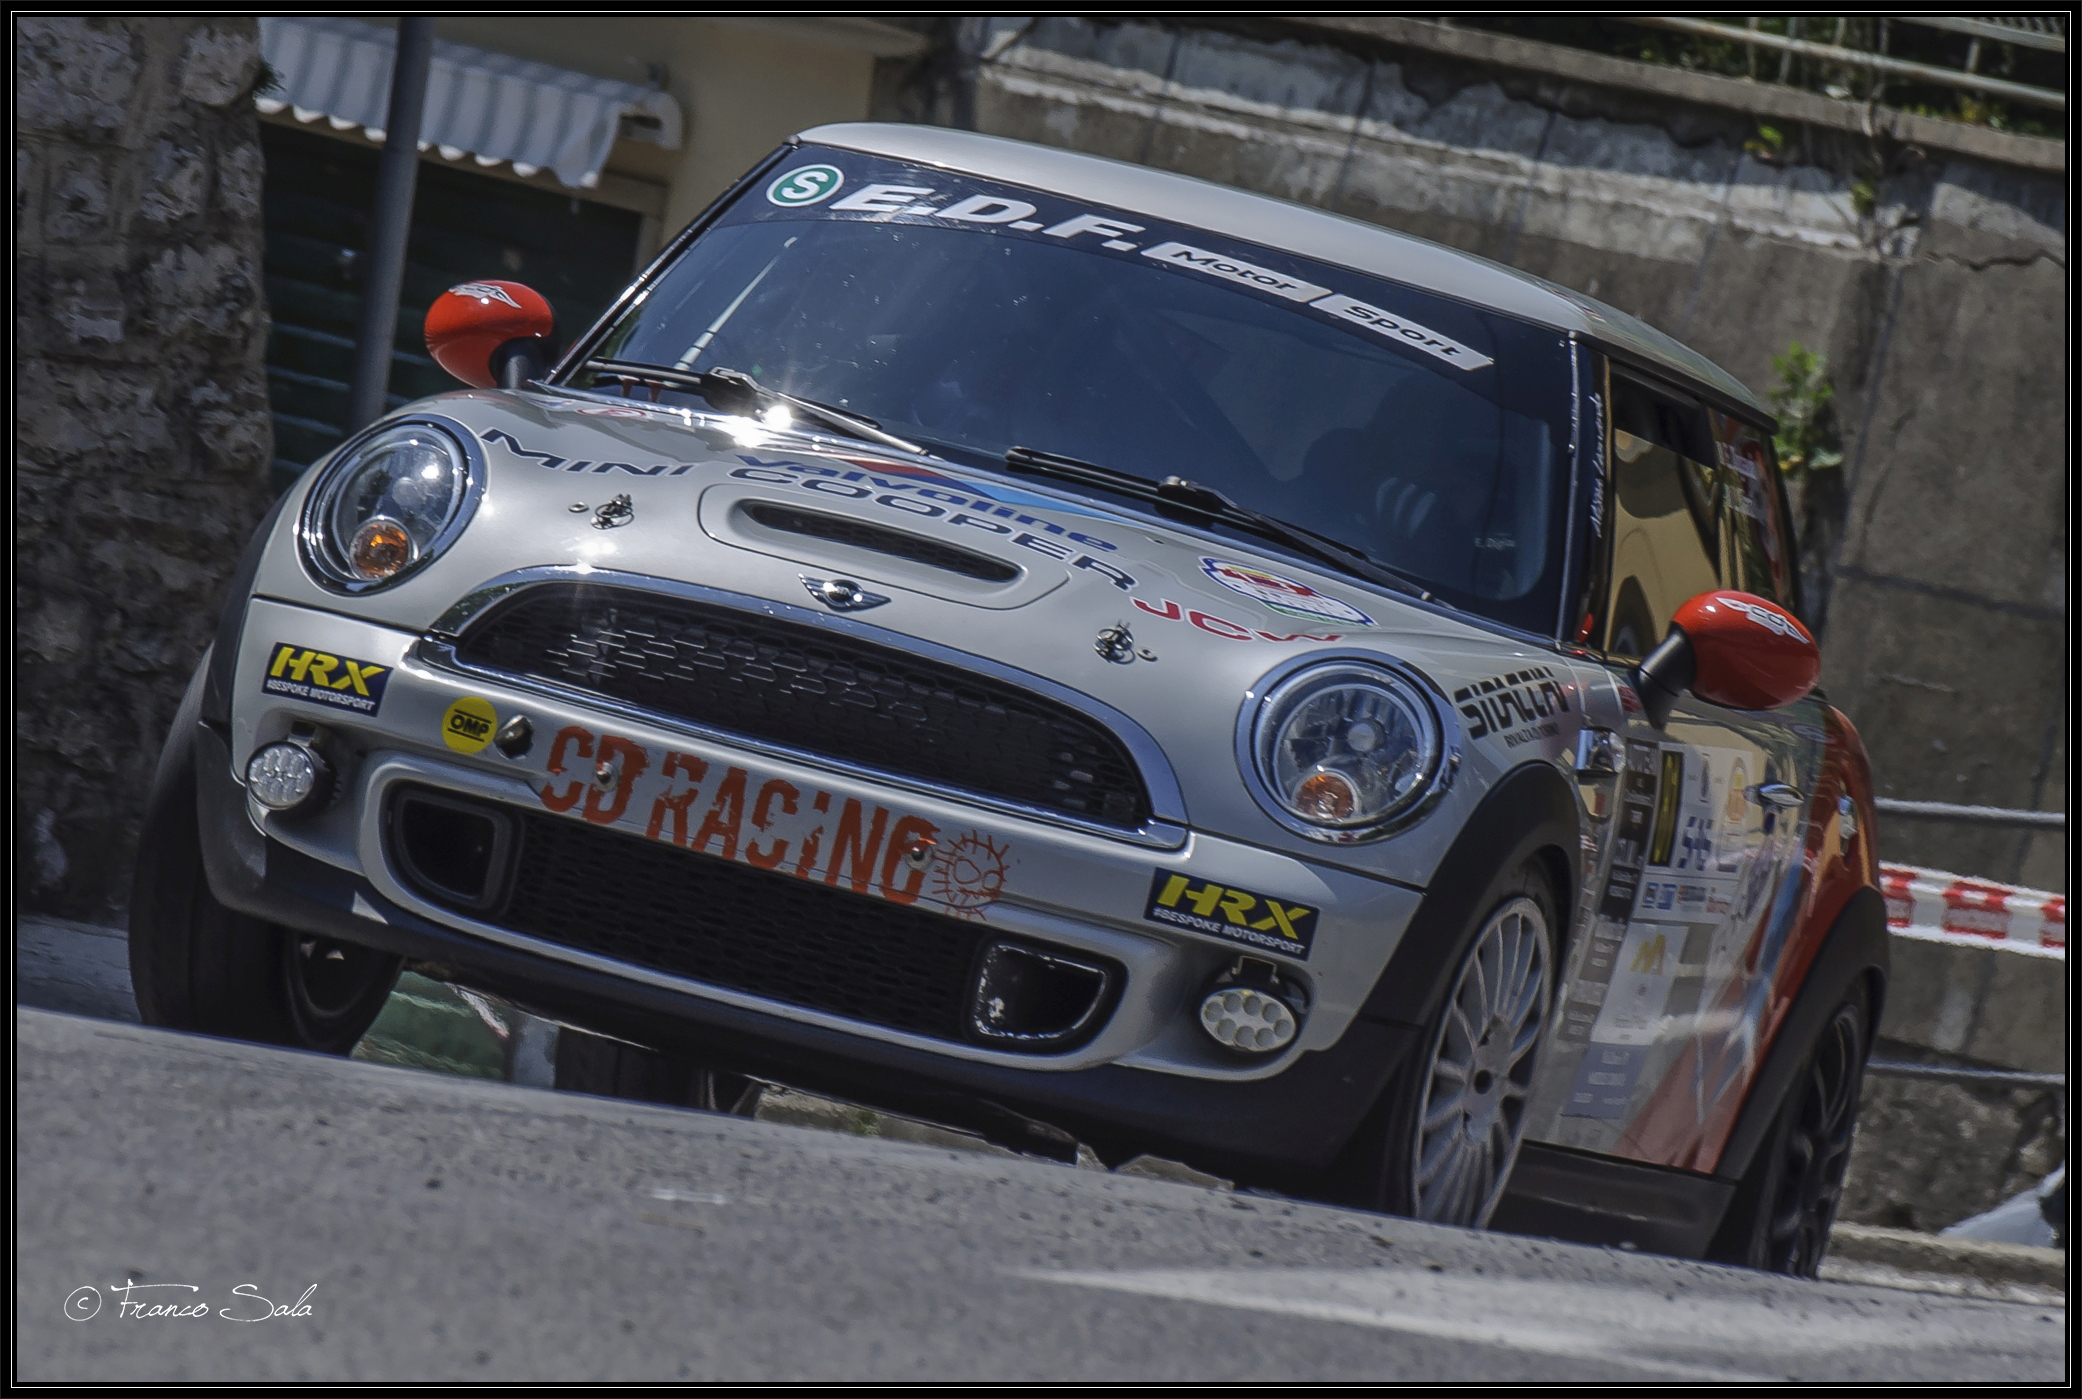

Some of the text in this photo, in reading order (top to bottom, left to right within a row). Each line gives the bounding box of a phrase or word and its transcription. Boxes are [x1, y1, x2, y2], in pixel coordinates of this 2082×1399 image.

[830, 183, 1465, 357] E.D.F. Motor Sport
[479, 427, 696, 478] MINI
[728, 466, 1138, 593] COOPER
[1133, 598, 1346, 643] JCW
[731, 453, 1119, 552] Valvoline
[267, 679, 376, 712] #BESPOKE MOTORSPORT
[270, 646, 385, 697] HRX
[450, 713, 491, 738] OMP
[540, 725, 941, 905] CD RACING
[1153, 906, 1306, 954] #BESPOKE MOTORSPORT
[1157, 873, 1312, 940] HRX
